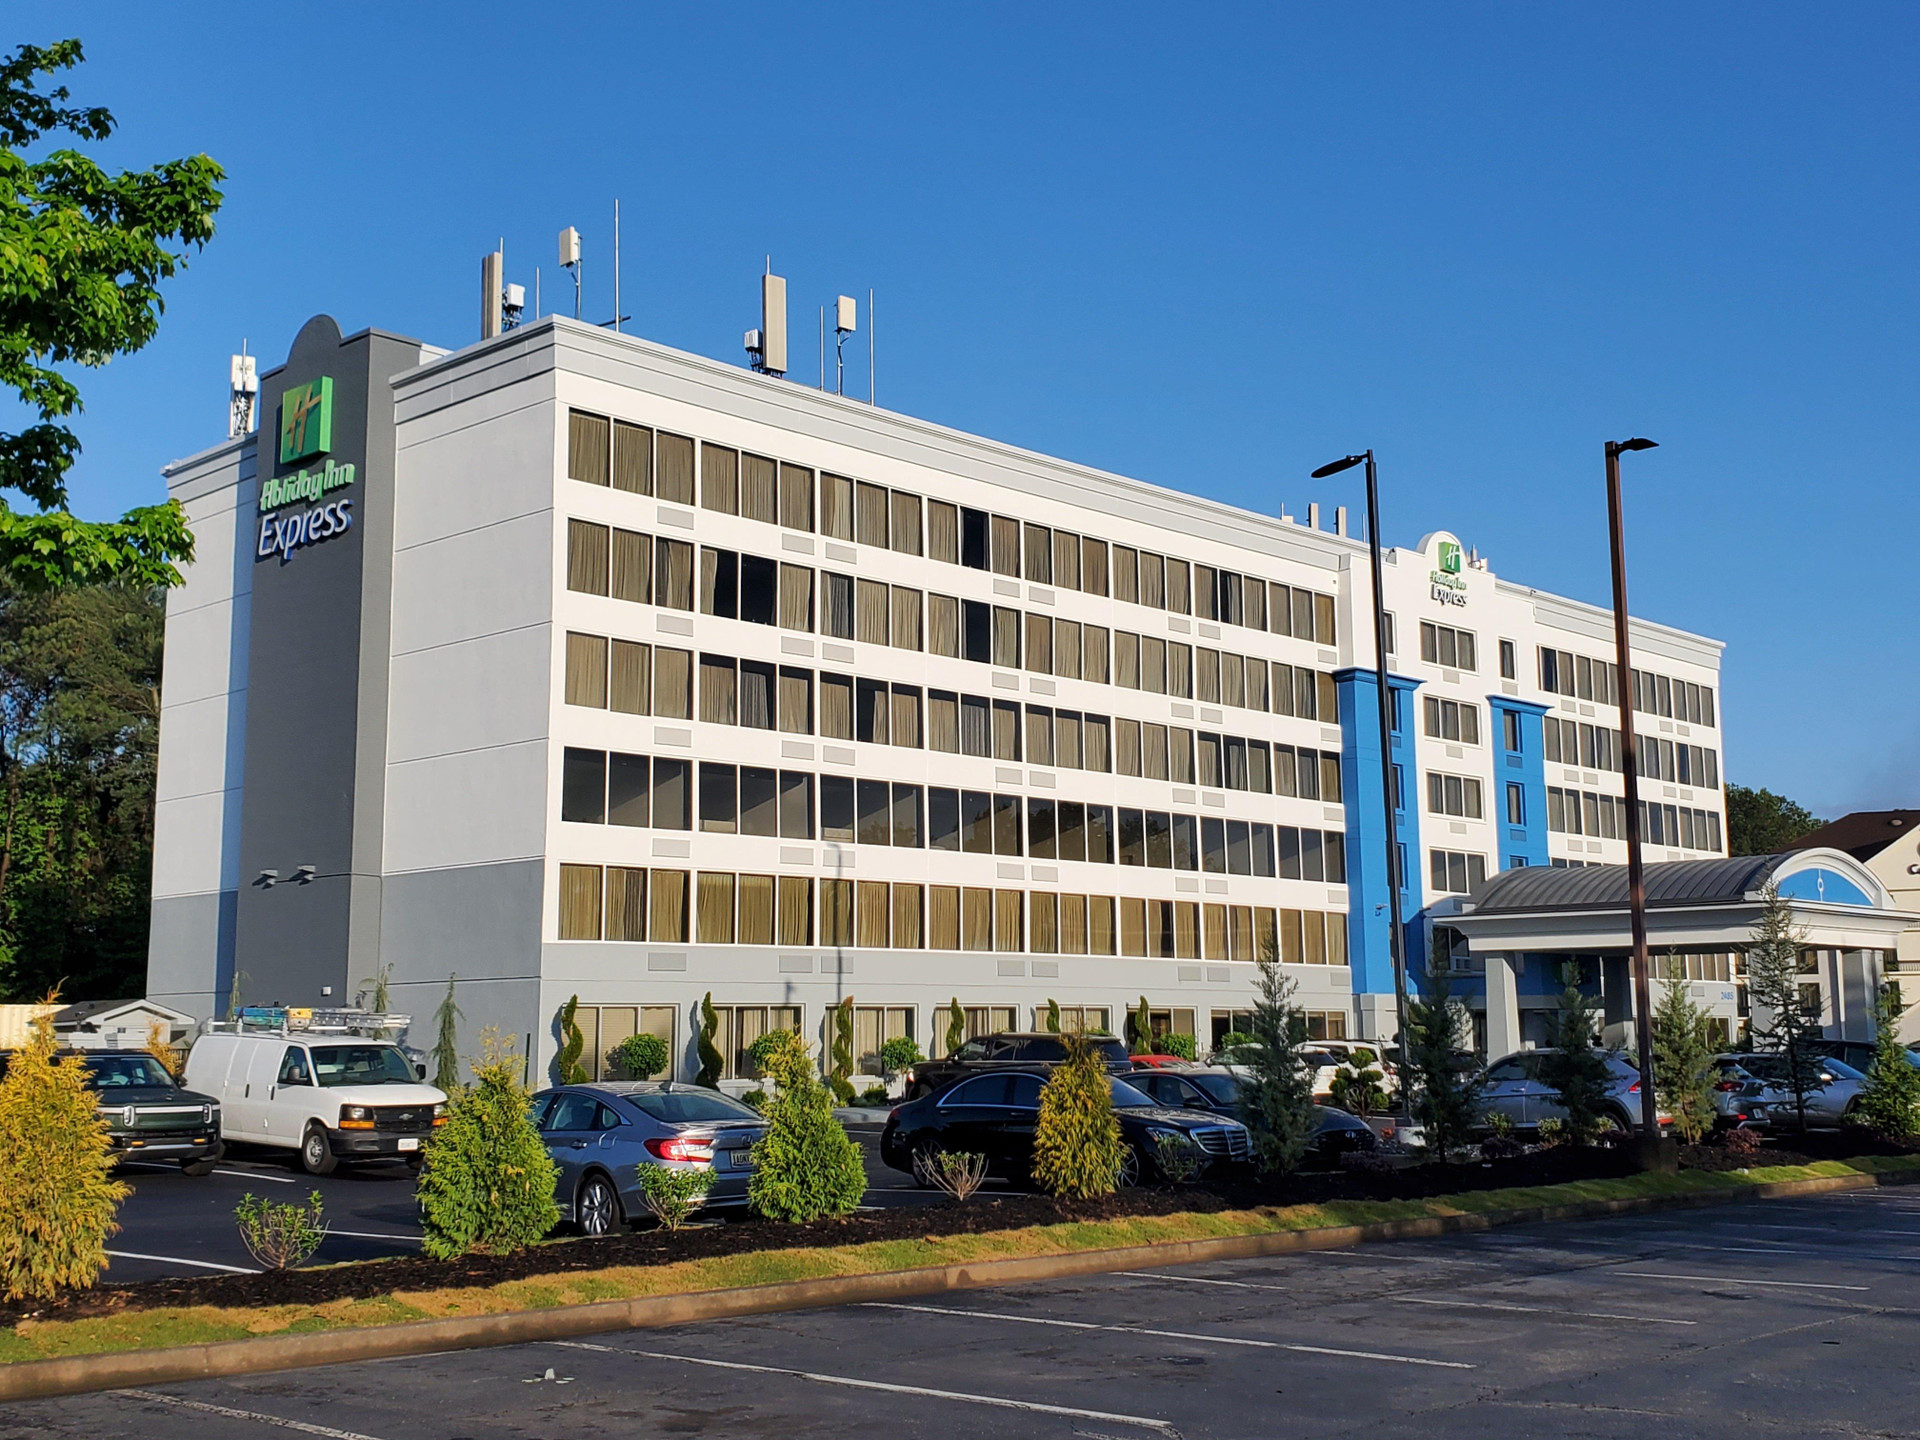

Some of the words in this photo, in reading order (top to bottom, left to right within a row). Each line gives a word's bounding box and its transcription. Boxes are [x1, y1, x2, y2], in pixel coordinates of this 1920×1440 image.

[260, 470, 324, 511] Holiday
[323, 459, 355, 490] Inn
[258, 499, 353, 560] Express
[1430, 570, 1454, 590] Holiday
[1431, 583, 1467, 608] Express
